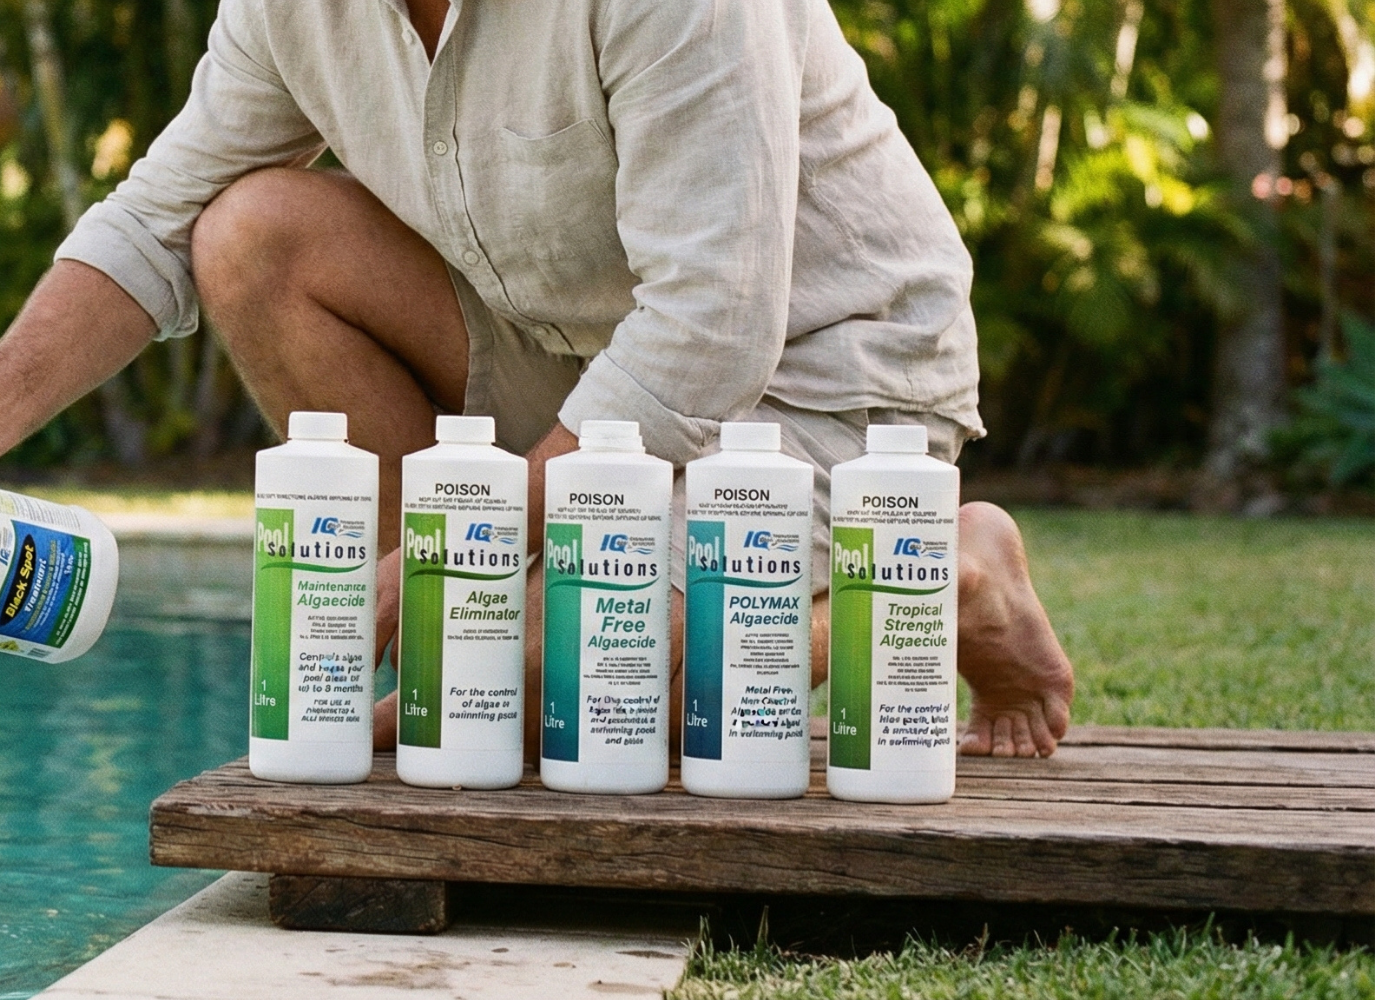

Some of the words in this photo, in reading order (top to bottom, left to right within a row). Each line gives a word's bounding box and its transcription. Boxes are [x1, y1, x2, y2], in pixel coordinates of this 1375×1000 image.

[435, 483, 491, 496] POISON
[714, 488, 770, 501] POISON
[569, 493, 624, 506] POISON
[862, 495, 919, 509] POISON
[257, 521, 289, 553] Pool
[406, 527, 441, 560] Pool
[546, 538, 578, 570] Pool
[688, 535, 720, 567] Pool
[834, 541, 869, 576] Pool
[5, 580, 29, 618] Black
[19, 543, 35, 580] Spot
[296, 593, 366, 609] Algaecide
[466, 590, 508, 608] Algae
[595, 597, 651, 614] Metal
[729, 596, 801, 610] POLYMAX
[449, 607, 521, 621] Eliminator
[888, 602, 943, 619] Tropical
[601, 616, 646, 633] Free
[729, 612, 799, 628] Algaecide
[883, 618, 944, 635] Strength
[587, 635, 657, 651] Algaecide
[879, 633, 948, 650] Algaecide
[261, 680, 267, 691] 1
[449, 687, 467, 696] For
[469, 687, 485, 697] the
[412, 688, 418, 701] 1
[405, 702, 428, 717] Litre
[461, 699, 473, 708] of
[474, 699, 501, 710] algae
[549, 701, 555, 714] 1
[692, 699, 698, 712] 1
[879, 703, 896, 713] For
[897, 703, 913, 713] the
[840, 707, 846, 720] 1
